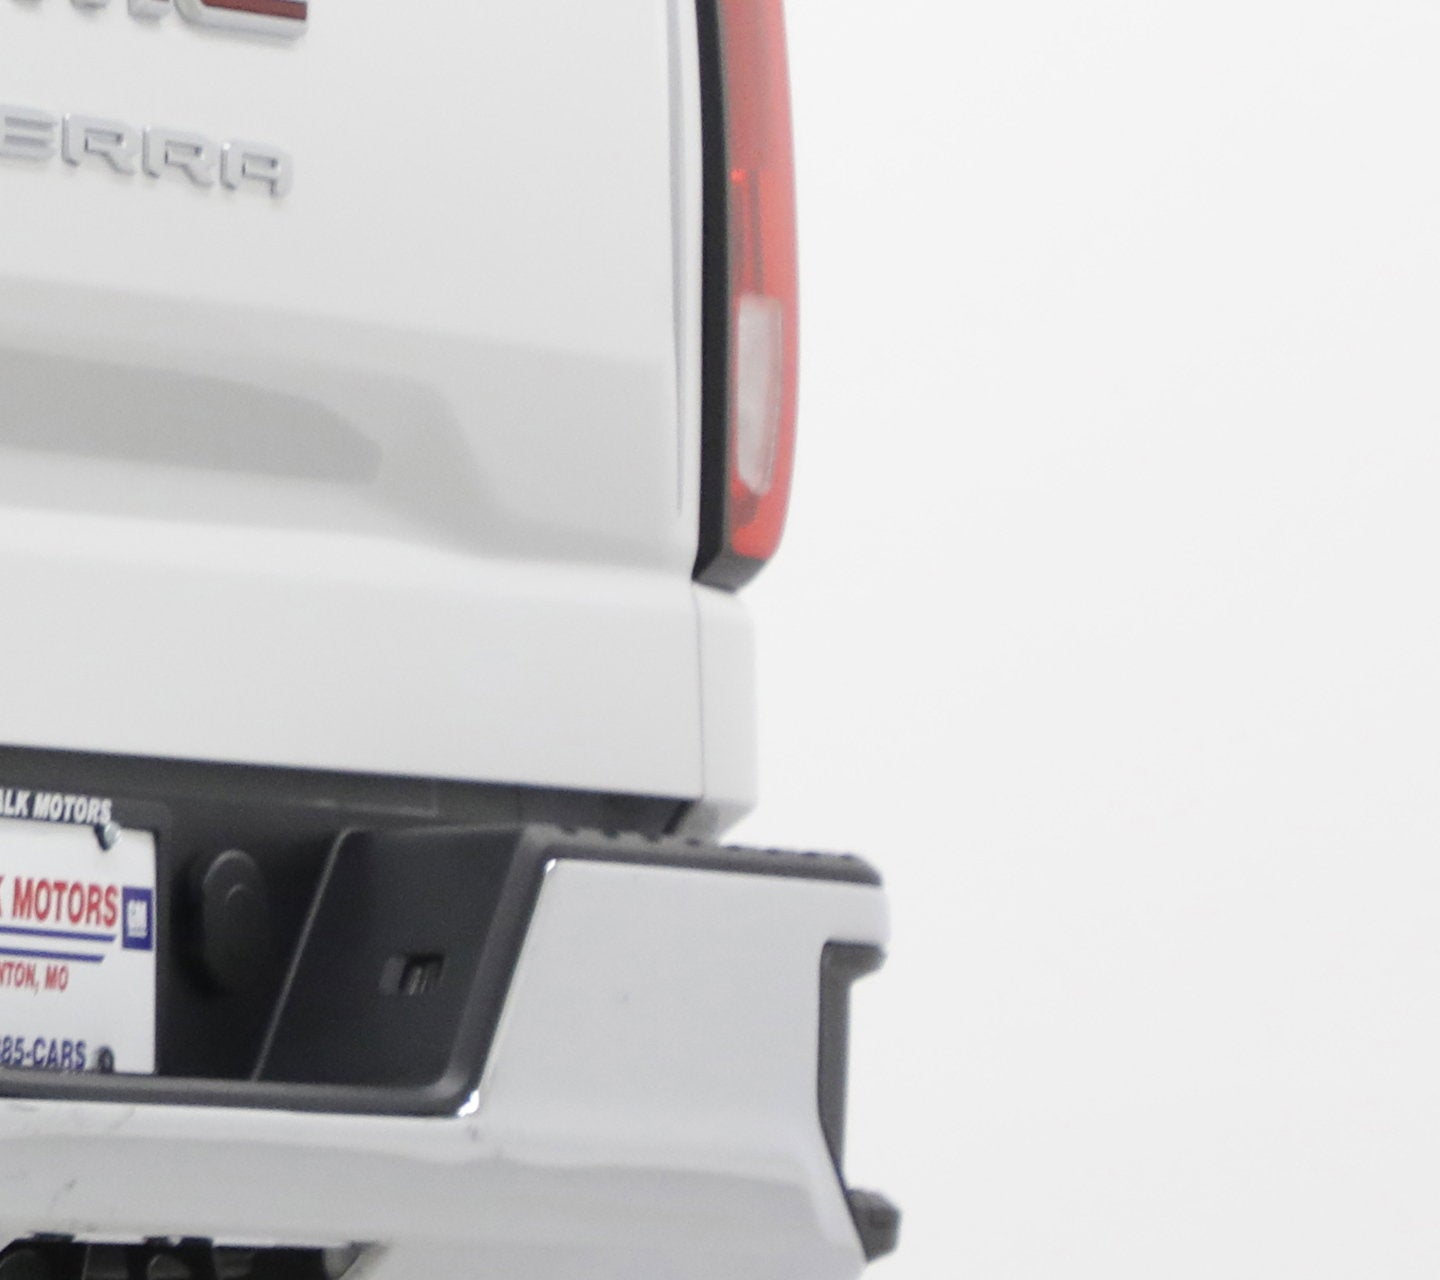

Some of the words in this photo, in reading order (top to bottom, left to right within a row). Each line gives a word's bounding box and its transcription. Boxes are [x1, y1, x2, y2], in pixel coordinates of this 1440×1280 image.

[34, 793, 113, 824] MOTORS
[12, 877, 118, 928] MOTORS
[45, 965, 69, 992] MO
